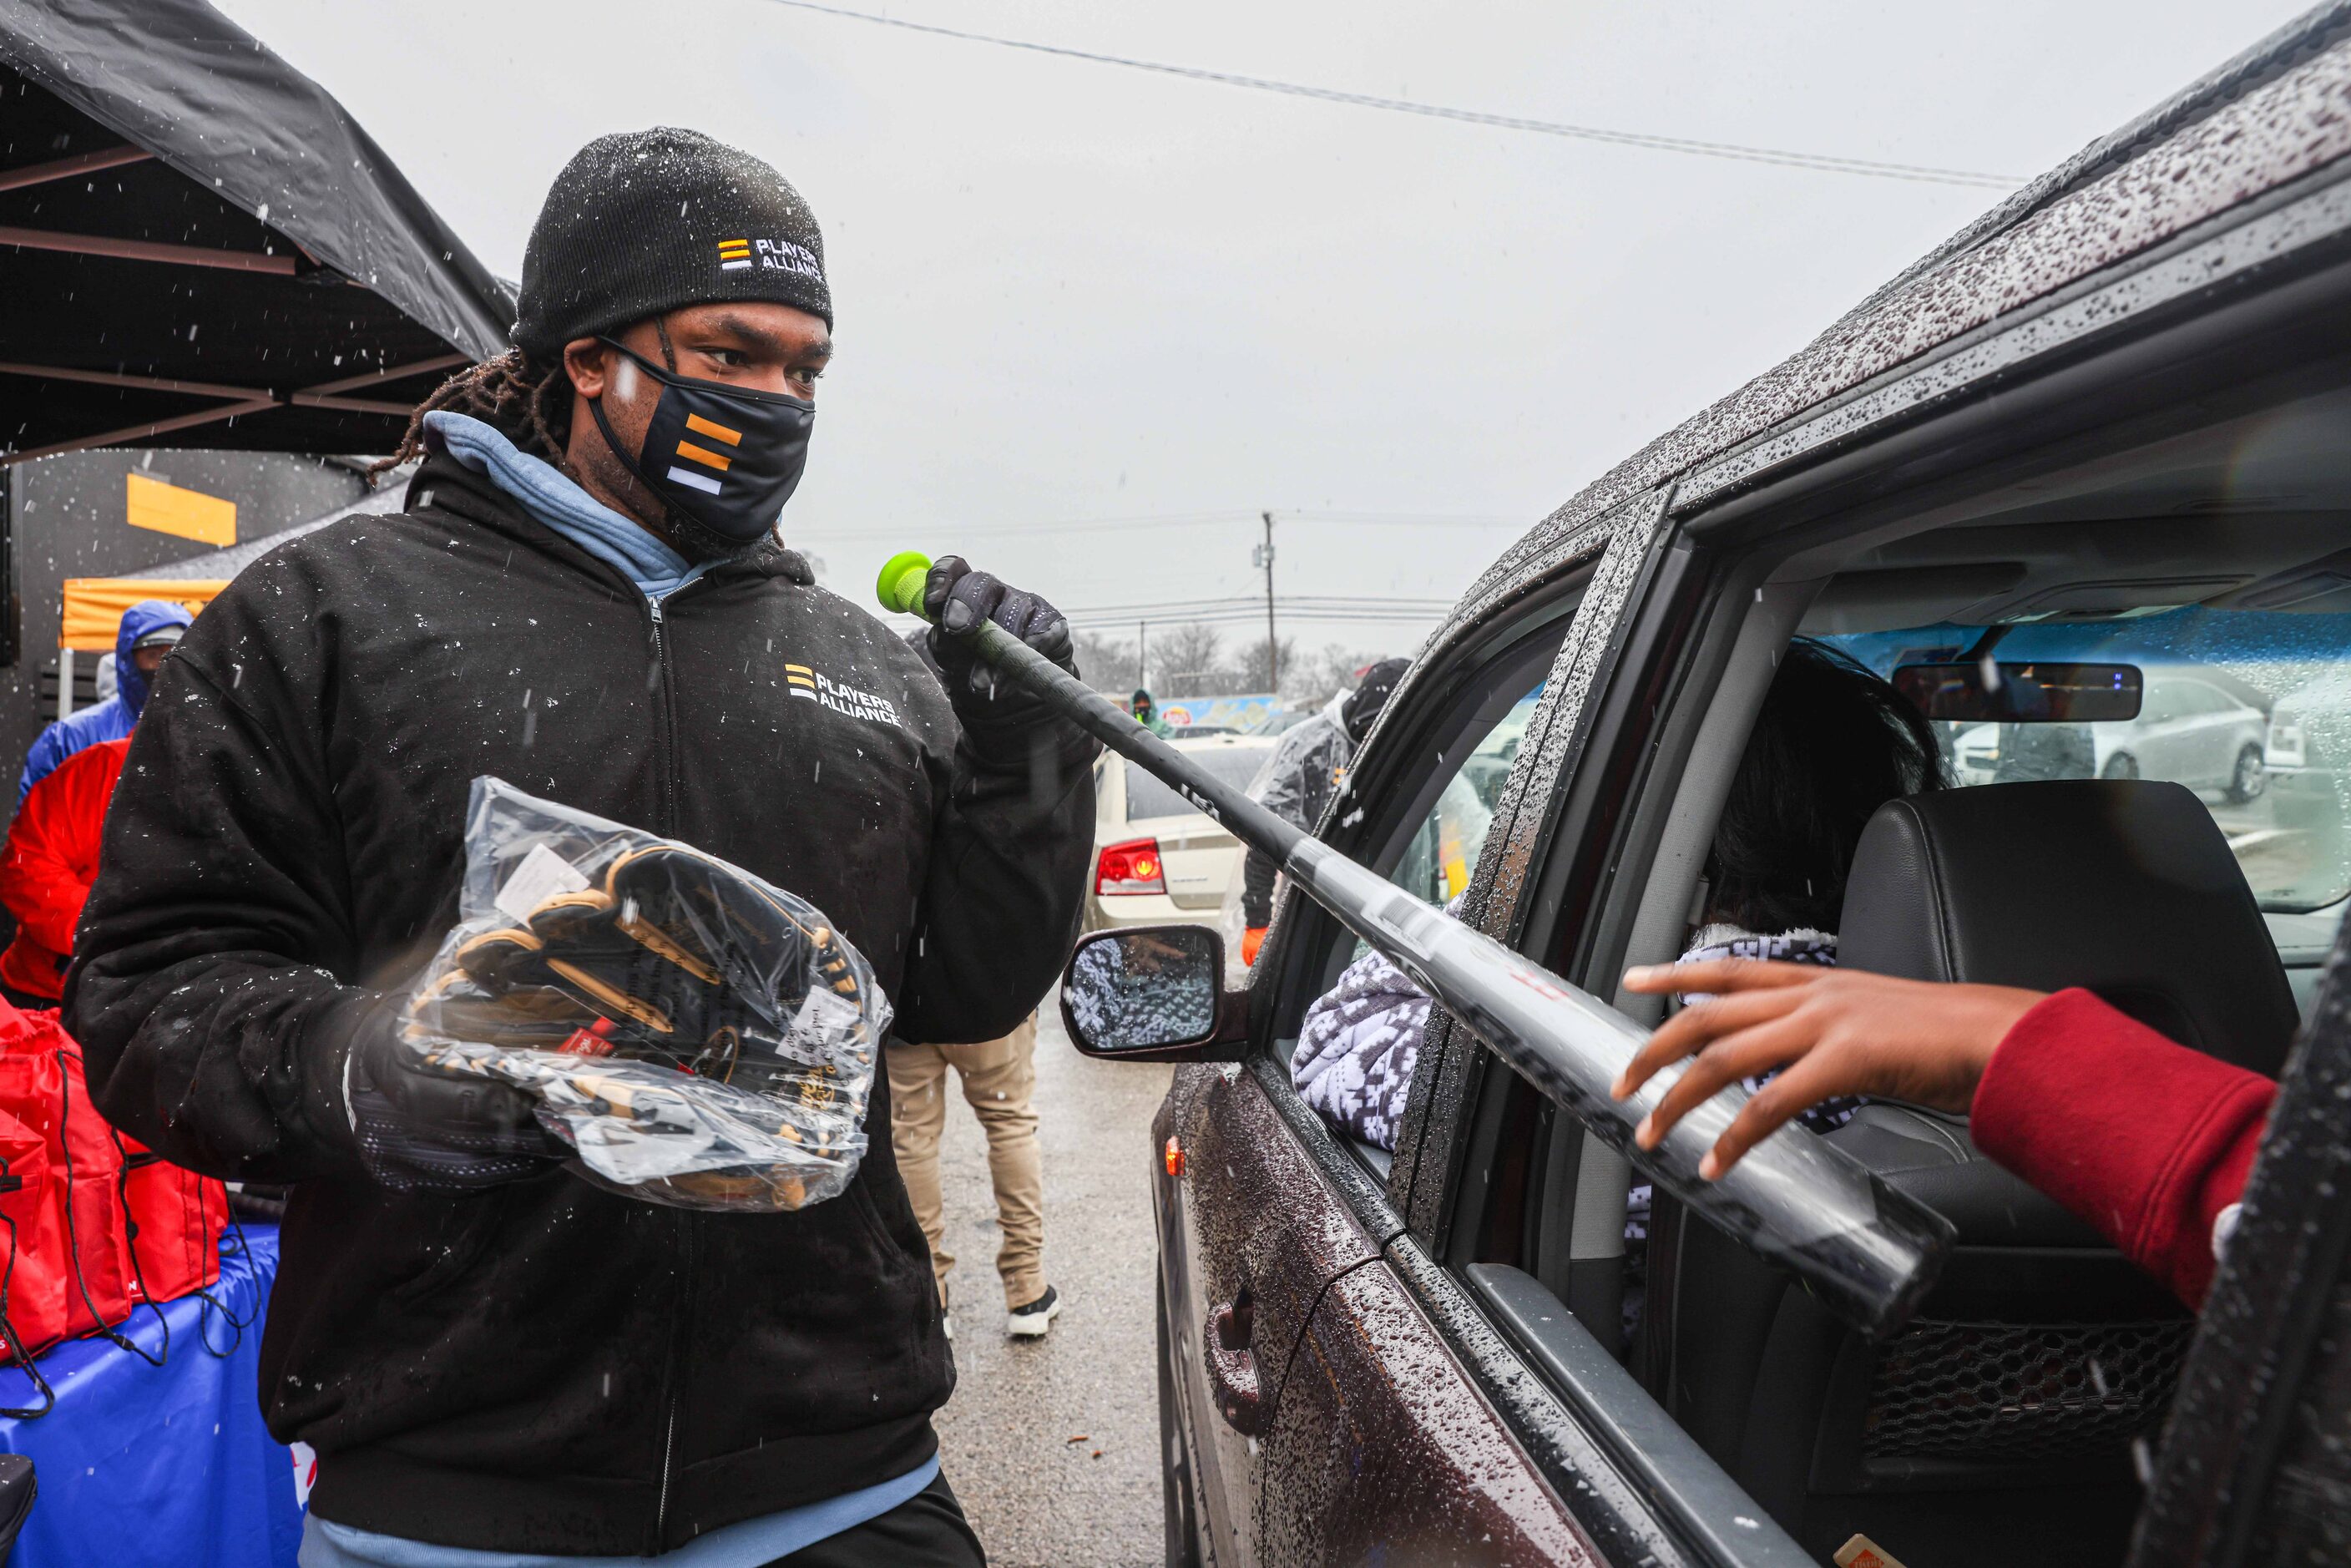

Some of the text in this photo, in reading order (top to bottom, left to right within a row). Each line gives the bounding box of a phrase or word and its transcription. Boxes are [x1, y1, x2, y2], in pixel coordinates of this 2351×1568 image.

[755, 239, 819, 267] PLAYERS
[815, 672, 896, 716] PLAYERS
[820, 691, 902, 729] ALLIANCE
